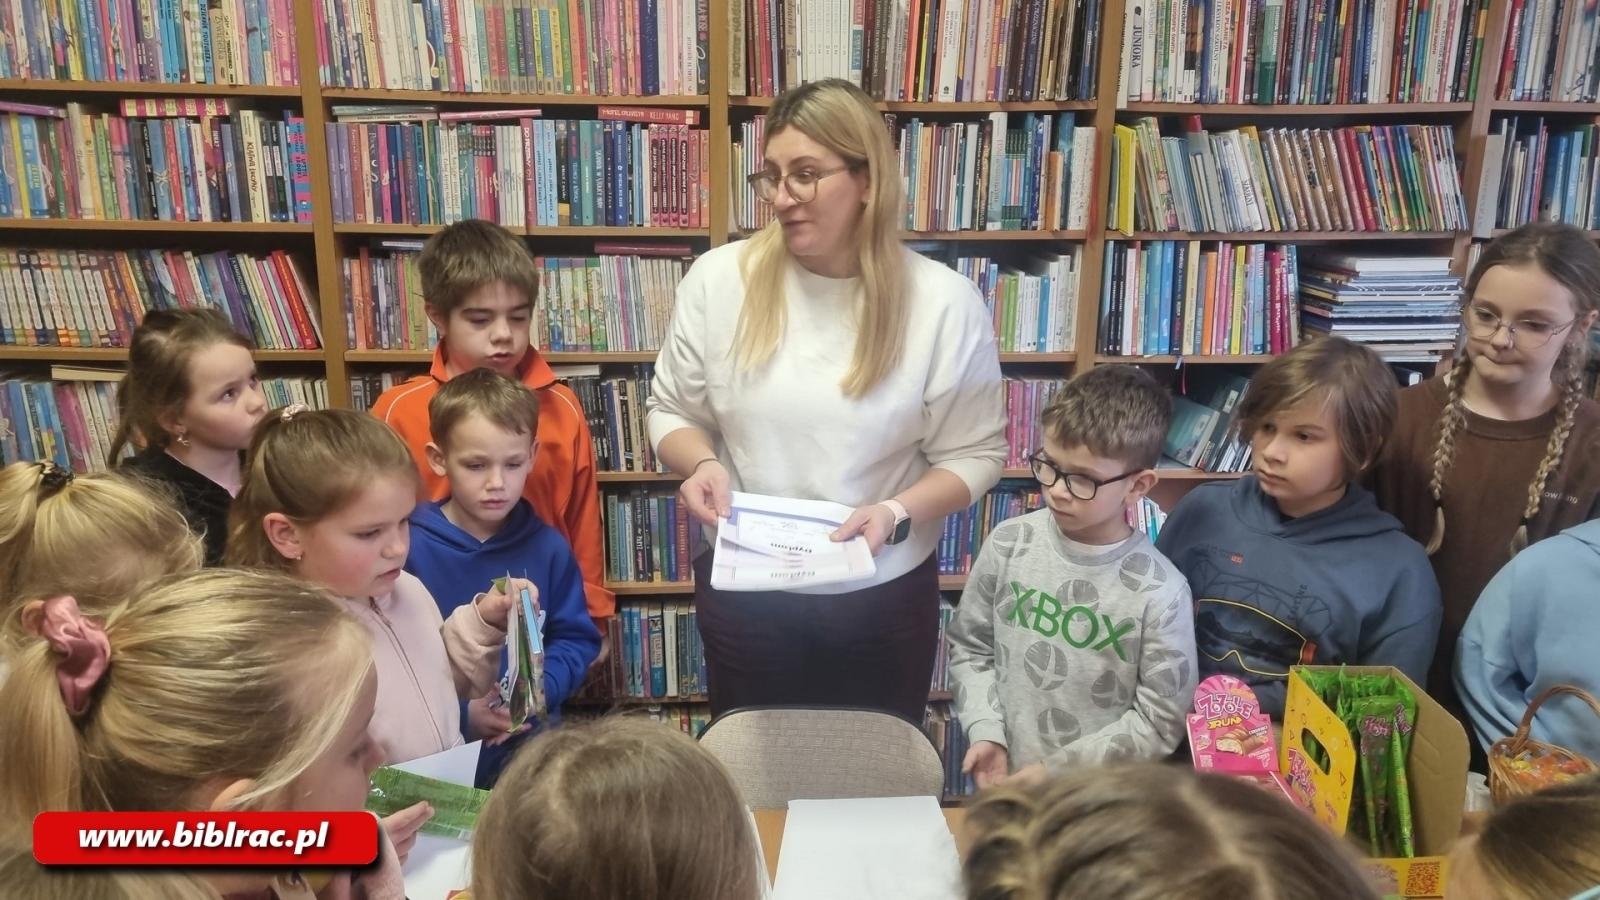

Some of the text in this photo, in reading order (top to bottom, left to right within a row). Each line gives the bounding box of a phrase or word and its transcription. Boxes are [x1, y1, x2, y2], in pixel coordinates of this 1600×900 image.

[1132, 25, 1142, 68] JUNIORA
[1007, 580, 1136, 662] XBOX
[1207, 715, 1242, 731] RUN
